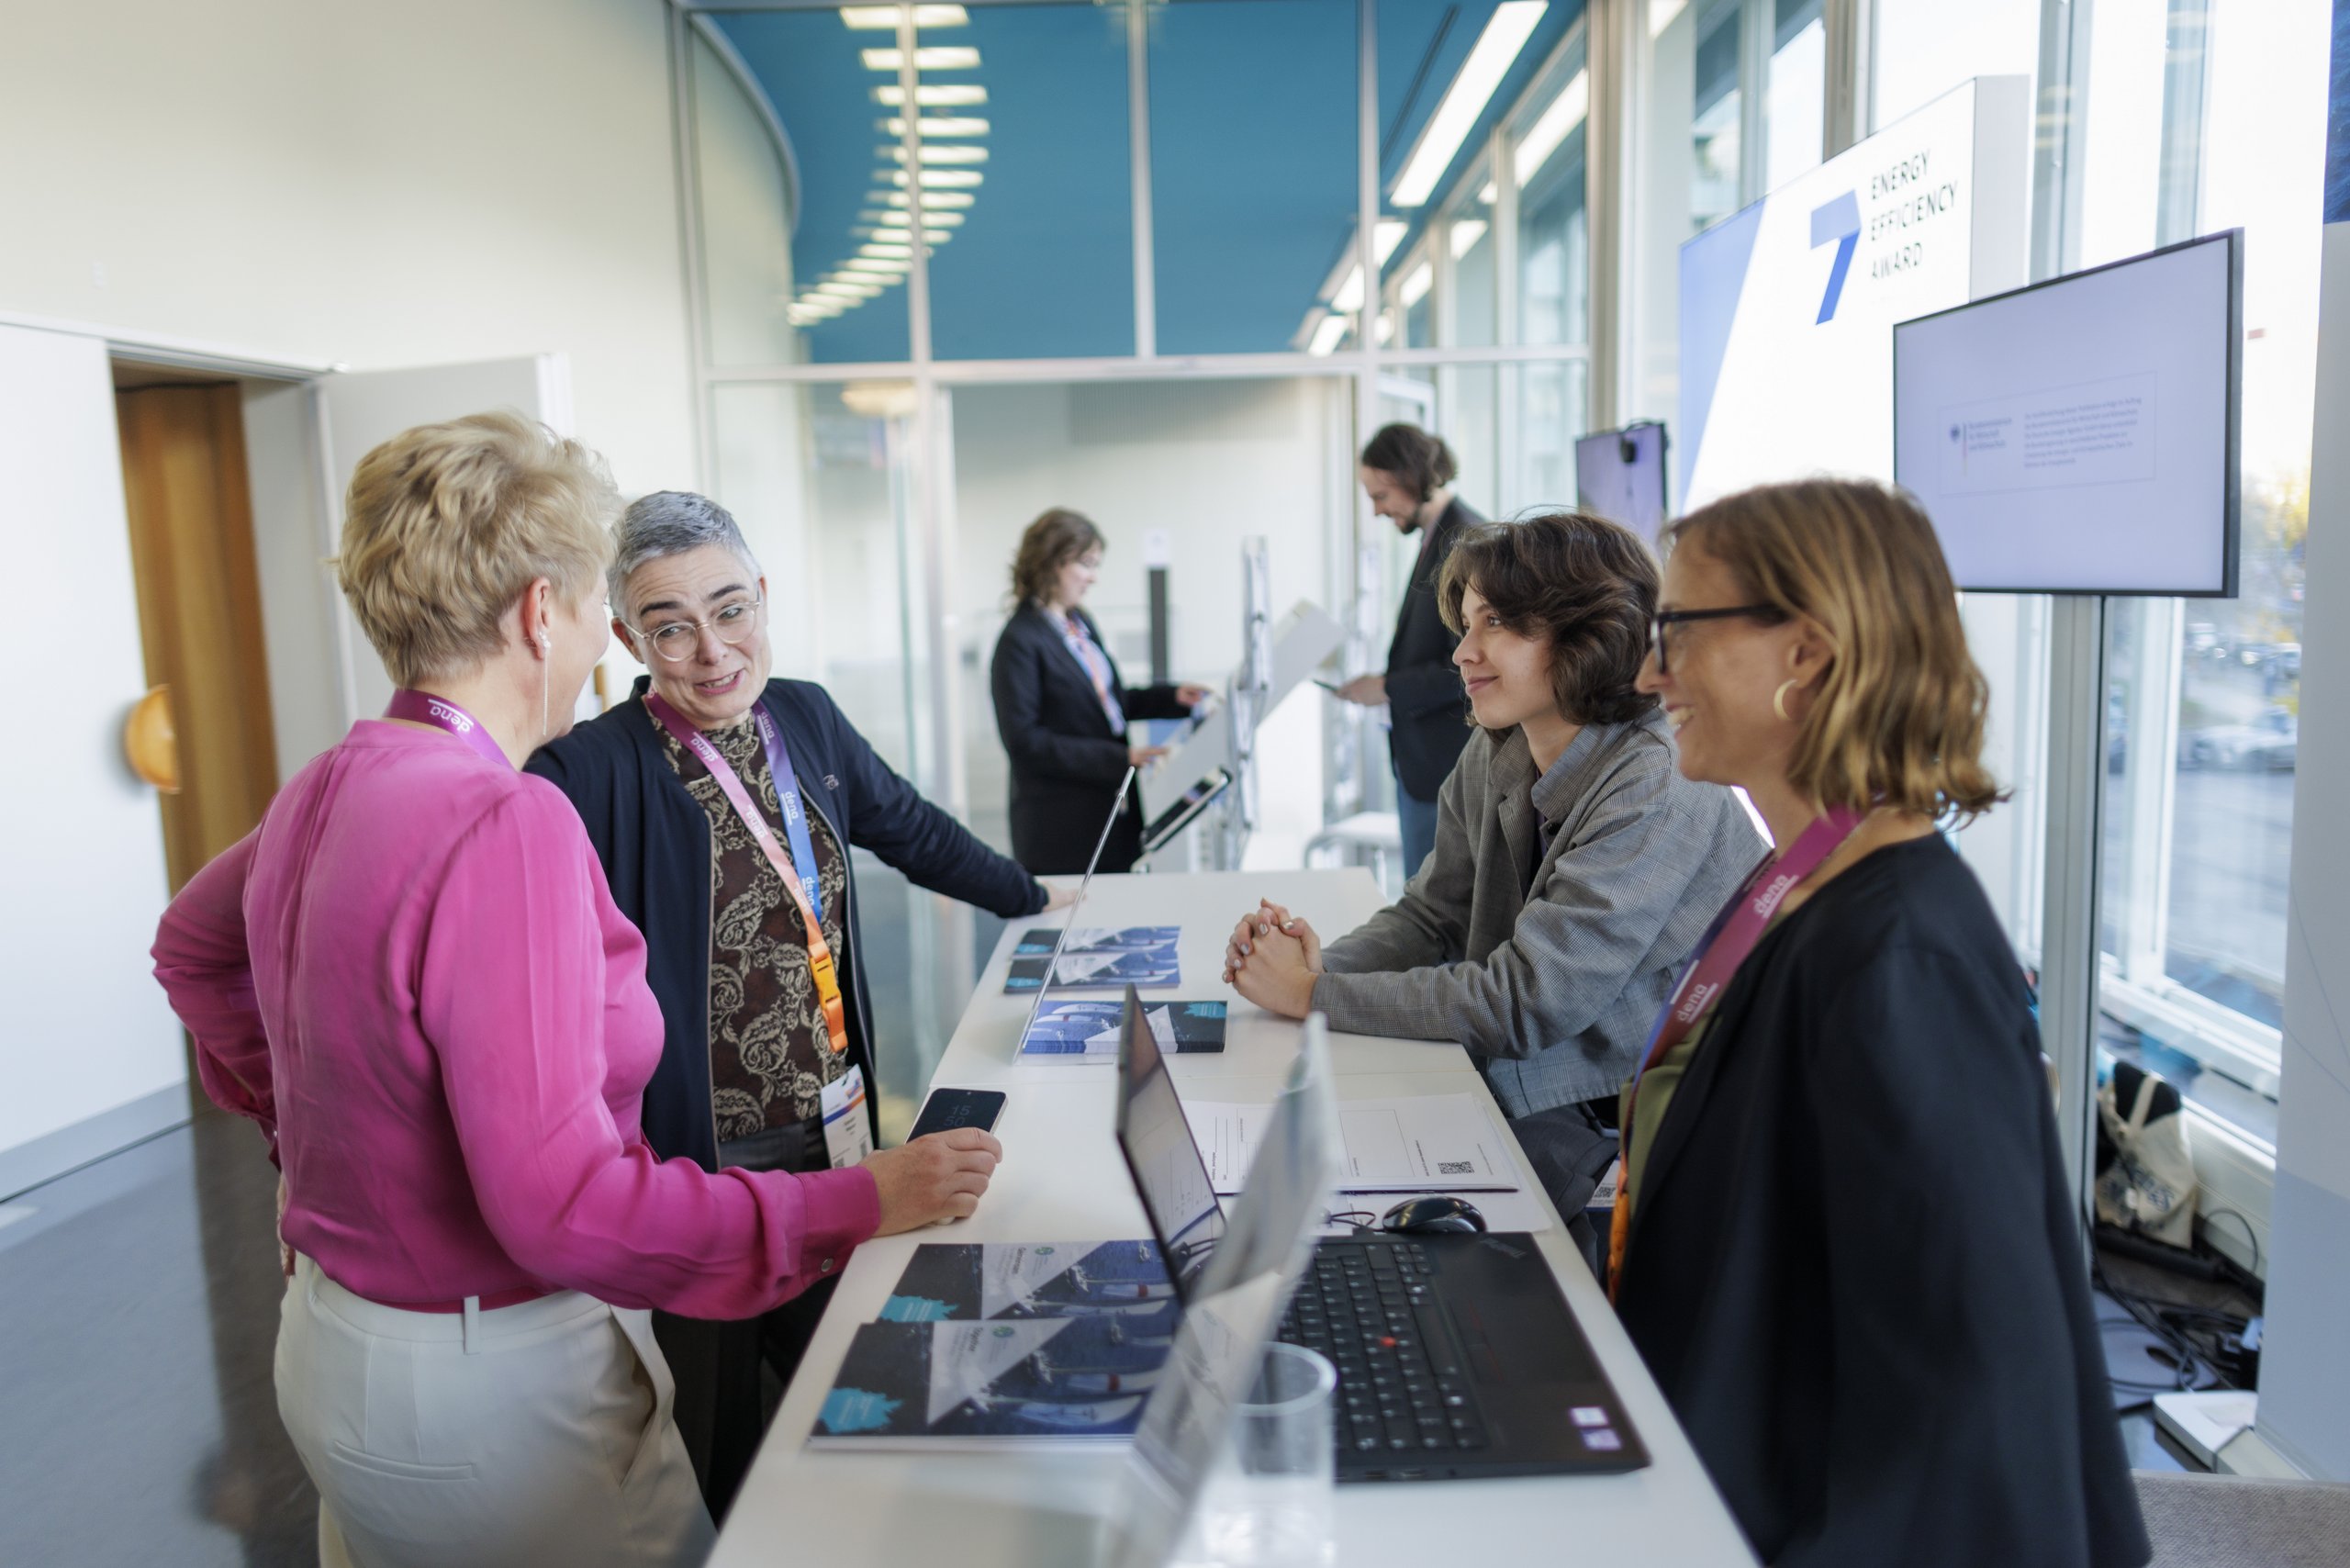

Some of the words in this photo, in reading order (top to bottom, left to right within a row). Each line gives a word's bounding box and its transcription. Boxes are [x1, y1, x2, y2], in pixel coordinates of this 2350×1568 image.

[1872, 150, 1930, 200] ENERGY
[1871, 181, 1958, 241] EFFICIENCY
[1872, 241, 1923, 279] AWARD
[430, 705, 471, 733] dena
[760, 711, 776, 739] dena
[690, 737, 717, 762] dena
[785, 791, 799, 819] dena
[745, 810, 766, 838] dena
[1753, 874, 1789, 914] dena
[1677, 983, 1708, 1022] dena
[952, 1104, 971, 1116] 15
